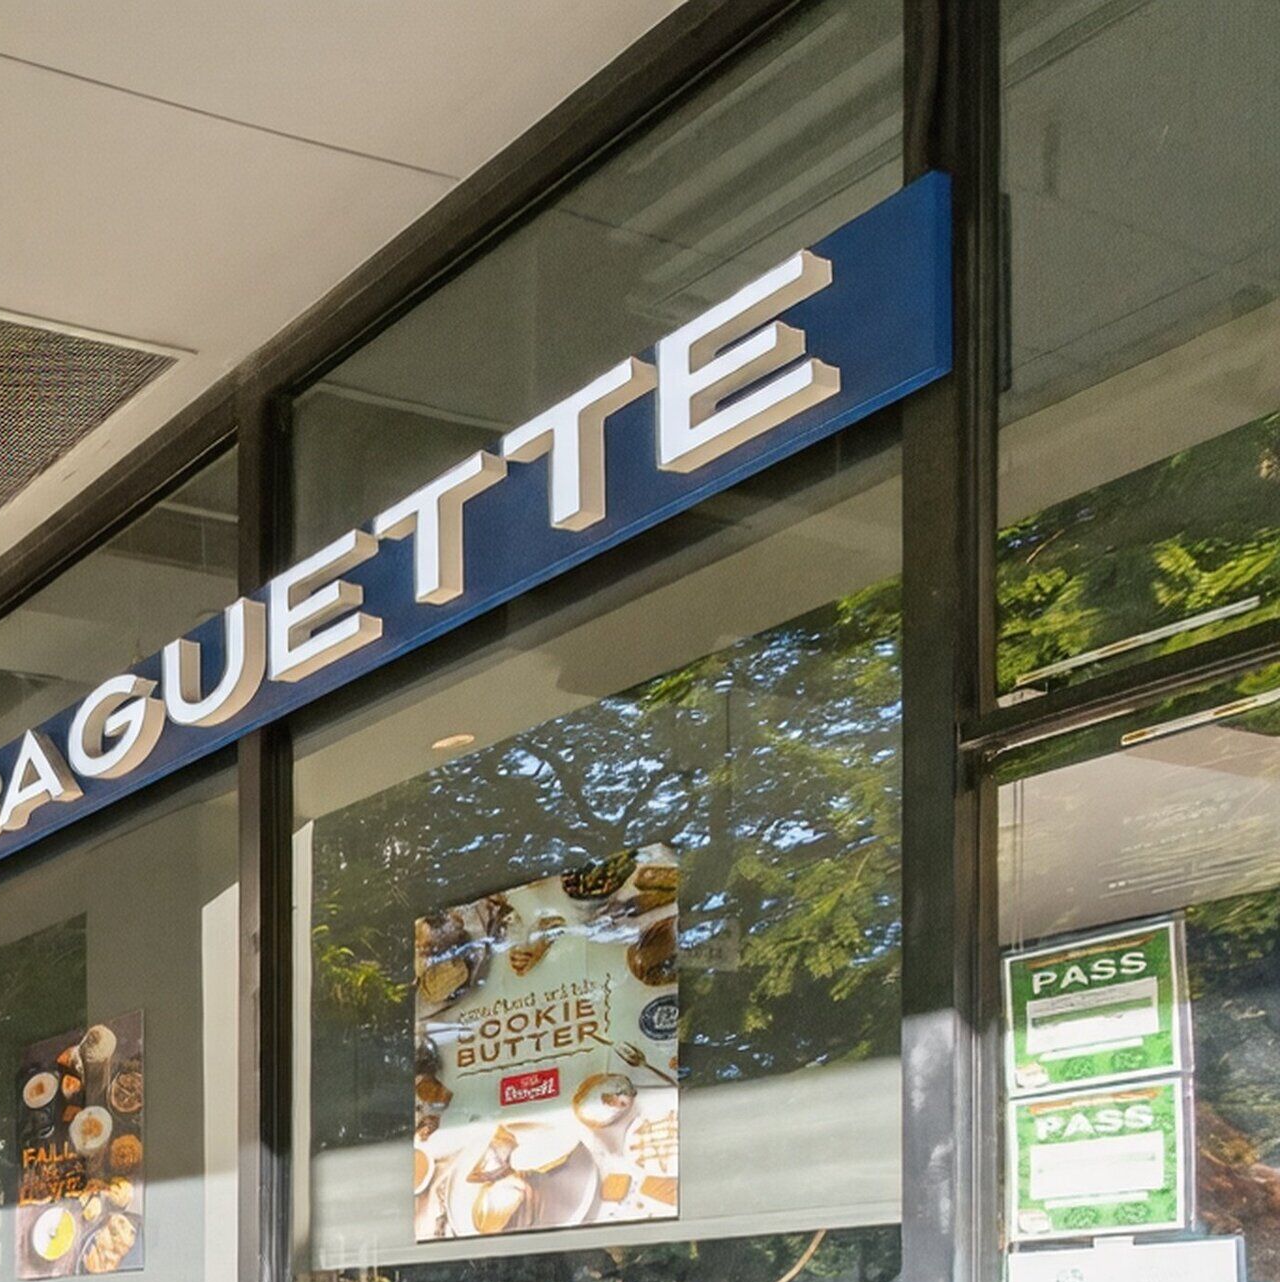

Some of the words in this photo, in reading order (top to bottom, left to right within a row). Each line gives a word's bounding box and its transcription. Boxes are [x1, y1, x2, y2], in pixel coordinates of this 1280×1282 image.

[1032, 951, 1148, 995] PASS
[457, 1021, 614, 1068] BUTTER
[1035, 1103, 1155, 1141] PASS
